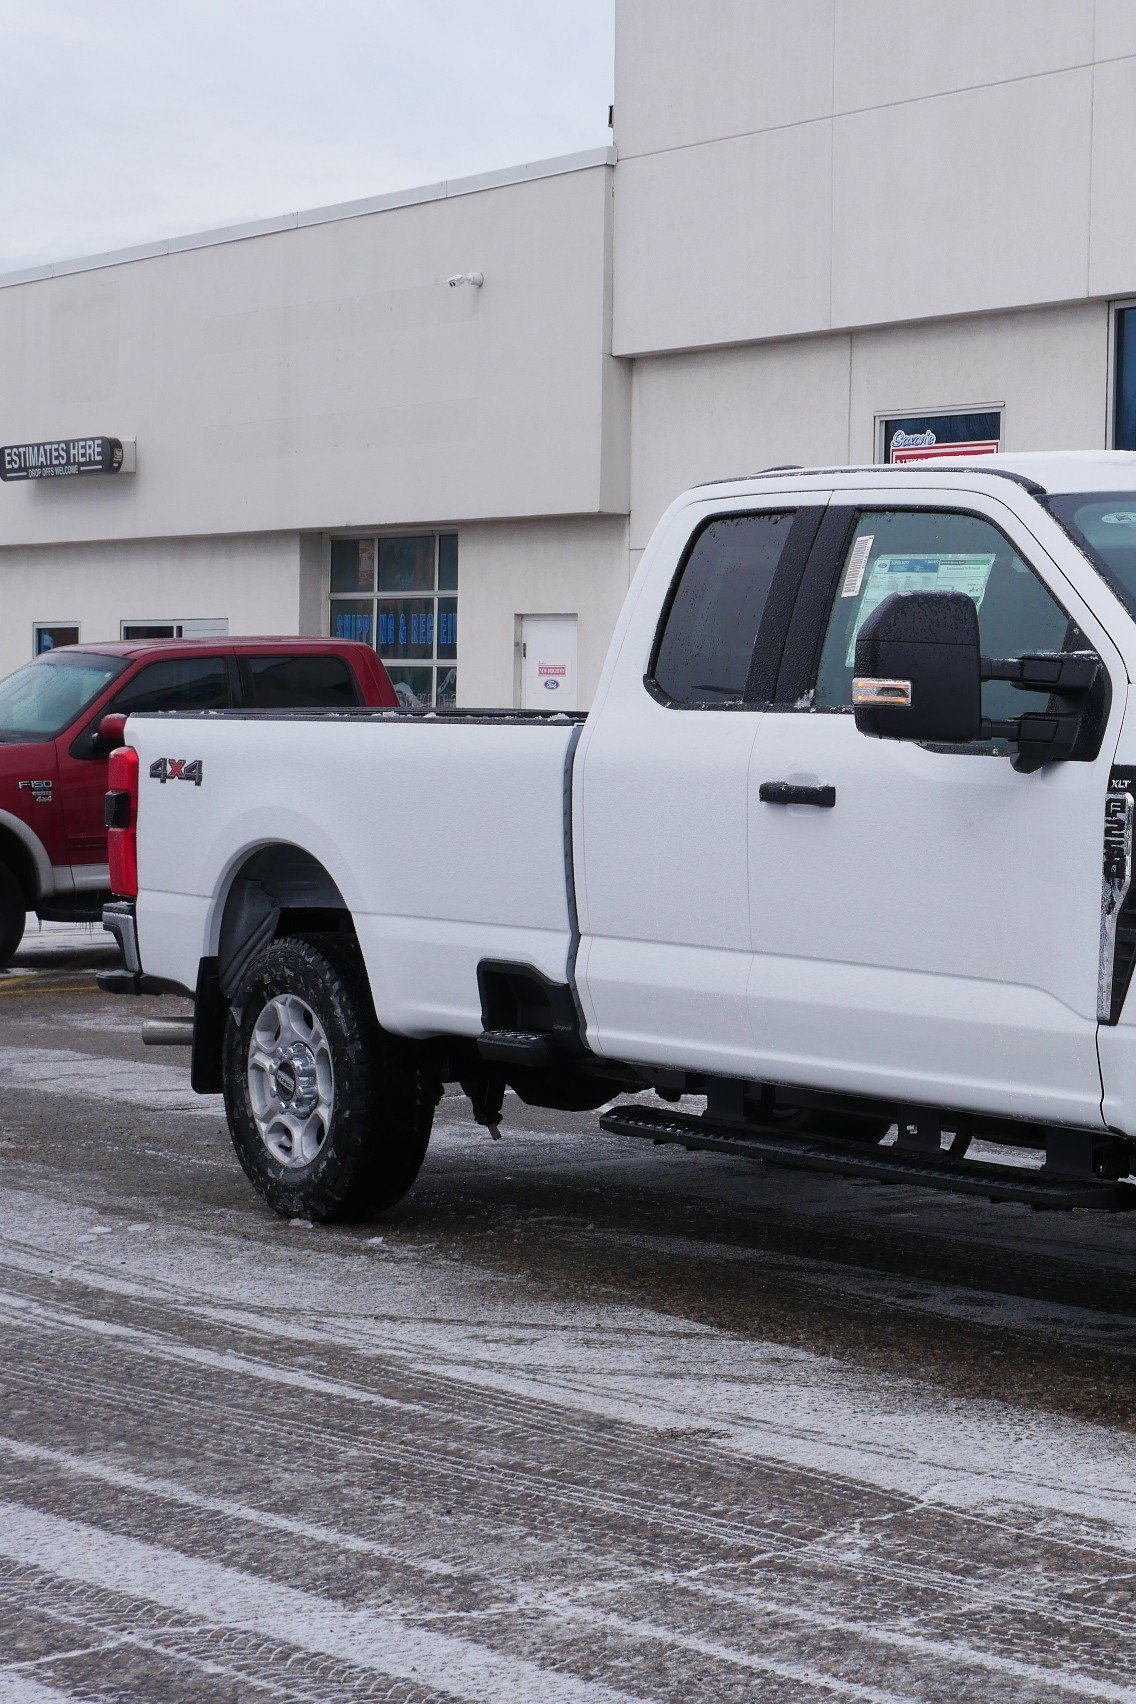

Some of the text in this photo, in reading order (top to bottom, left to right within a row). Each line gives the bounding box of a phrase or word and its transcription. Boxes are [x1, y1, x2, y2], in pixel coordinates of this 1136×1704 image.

[4, 442, 67, 469] ESTIMATES
[70, 439, 102, 463] HERE
[28, 468, 42, 478] DROP
[55, 465, 79, 475] WELCOME
[336, 613, 395, 644] SHIPPING
[400, 613, 407, 645] &
[1110, 779, 1131, 788] XLT
